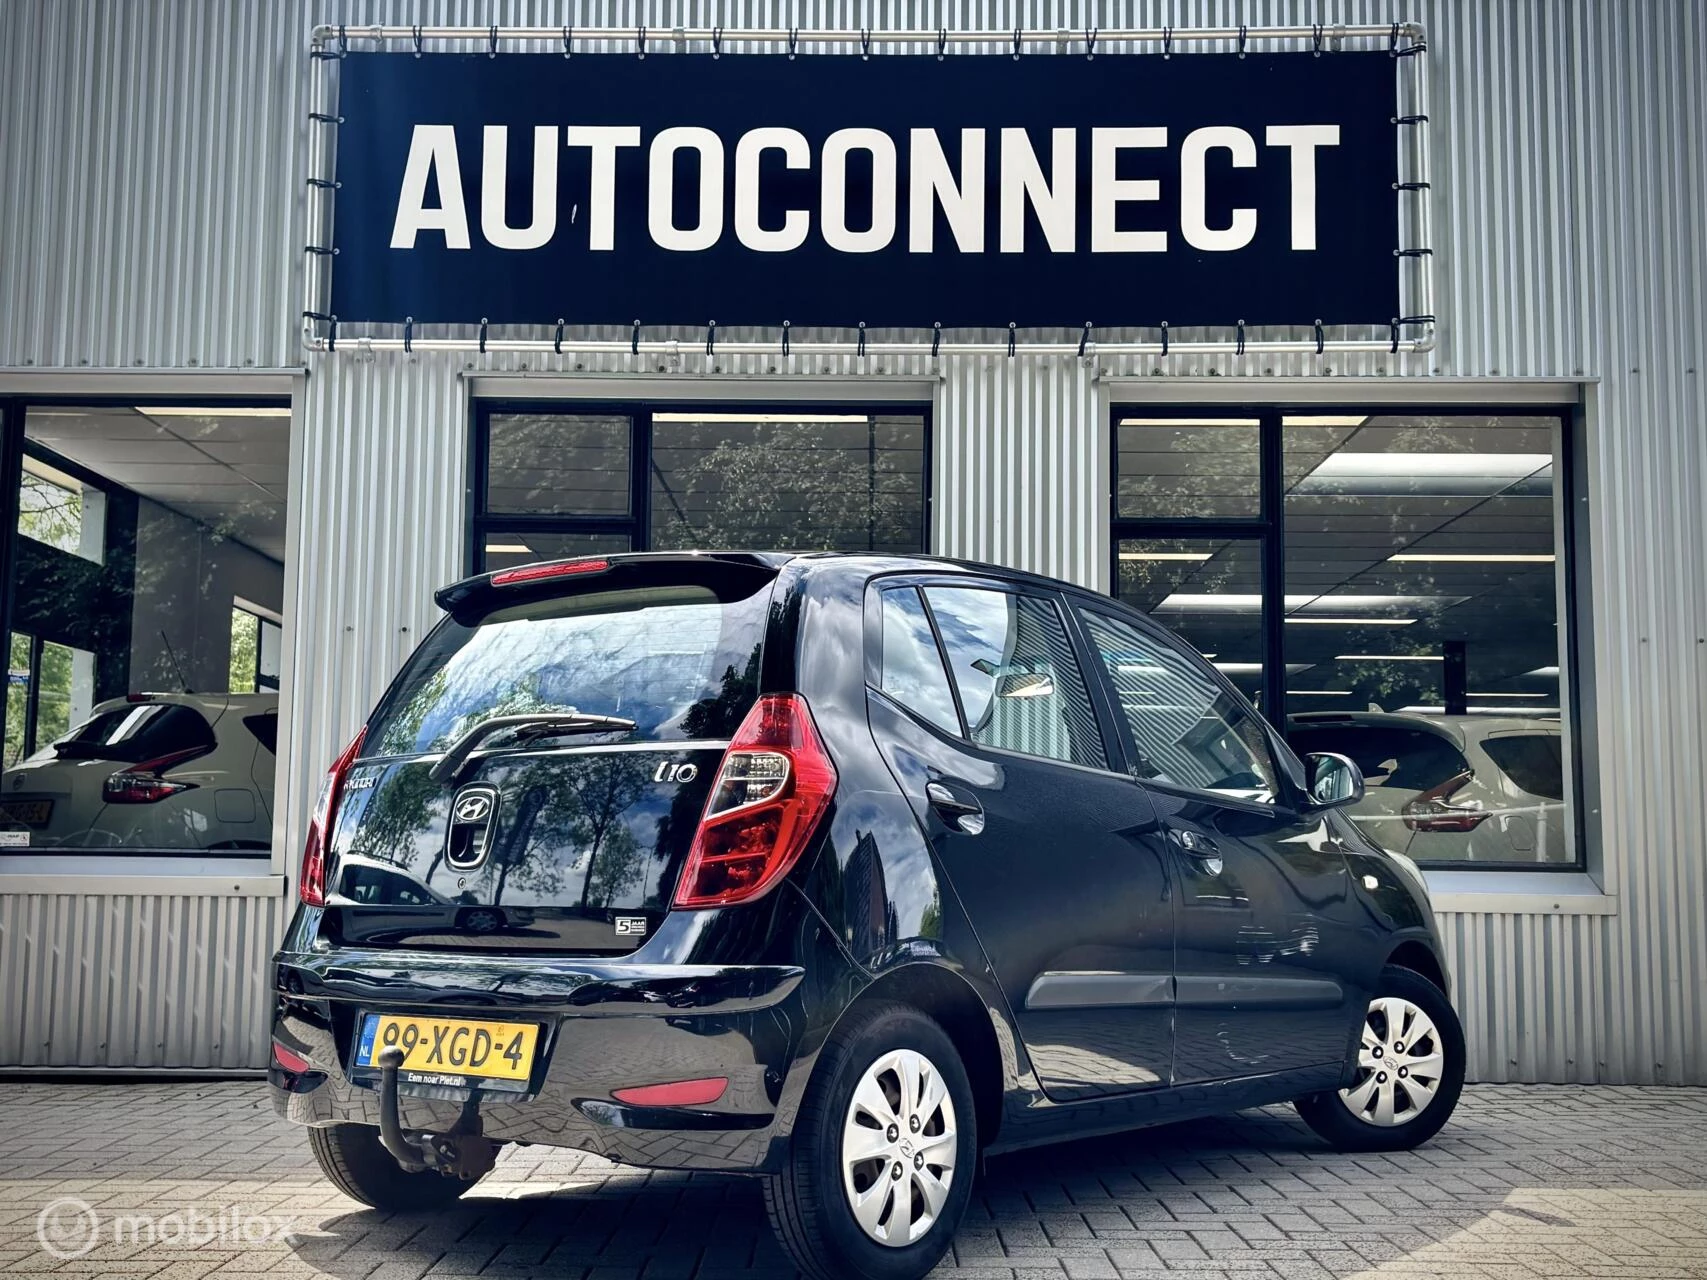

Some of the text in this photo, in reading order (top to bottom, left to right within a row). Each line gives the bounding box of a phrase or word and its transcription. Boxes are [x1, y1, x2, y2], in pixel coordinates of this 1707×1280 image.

[390, 125, 1339, 252] AUTOCONNECT
[618, 921, 629, 931] 5
[359, 1045, 371, 1058] NL
